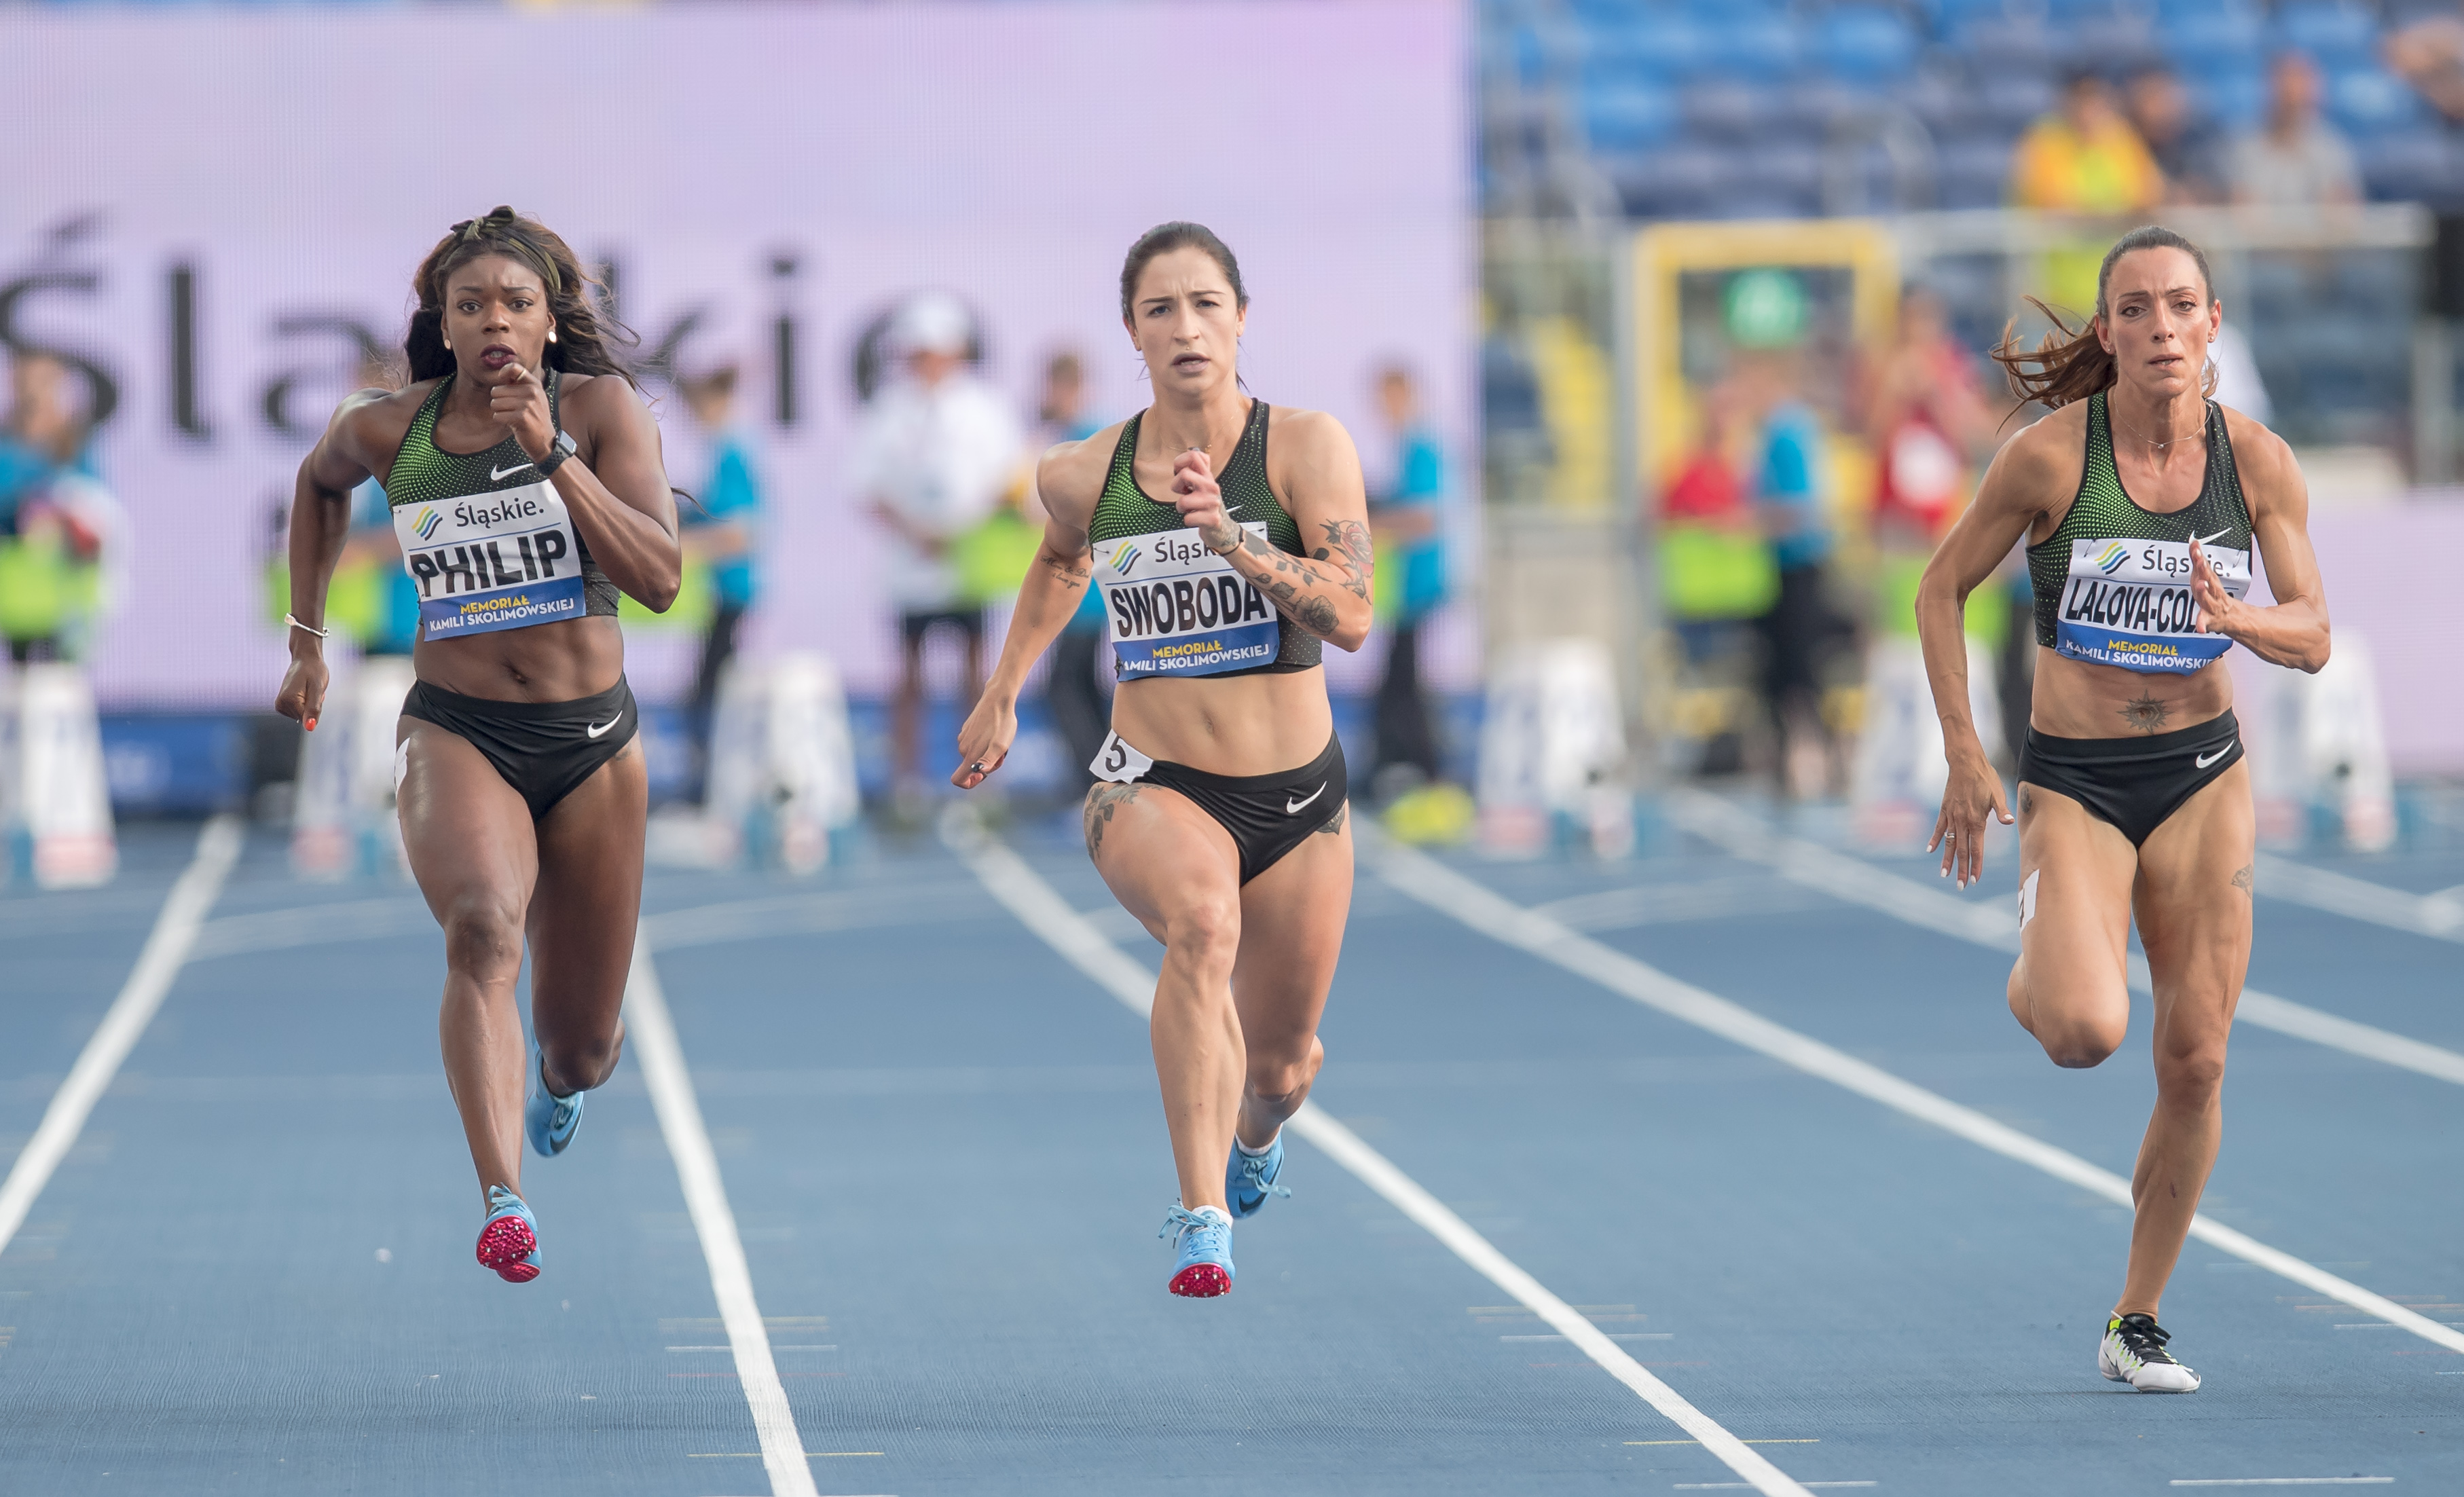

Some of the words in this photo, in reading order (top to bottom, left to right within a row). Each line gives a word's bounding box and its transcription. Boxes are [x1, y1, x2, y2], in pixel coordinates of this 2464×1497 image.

[454, 497, 544, 529] Śląskie.
[409, 529, 568, 597] PHILIP
[1155, 536, 1217, 566] Śląsk
[2142, 544, 2230, 578] Śląsie.
[430, 614, 464, 631] KAMILI
[467, 597, 574, 625] SKOLIMOWSKIEJ
[460, 595, 530, 614] MEMORIAŁ
[1109, 574, 1268, 637] SWOBODA
[2065, 578, 2235, 635] LALOVA-COL
[1121, 659, 1156, 671] AMILI
[1159, 644, 1270, 671] SKOLIMOWSKIEJ
[1152, 640, 1223, 659] MEMORIAŁ
[2065, 640, 2110, 661] KAMILI
[2112, 652, 2213, 669] SKOLIMOWSKI
[2108, 640, 2178, 656] MEMORIAŁ
[1105, 735, 1126, 773] 5
